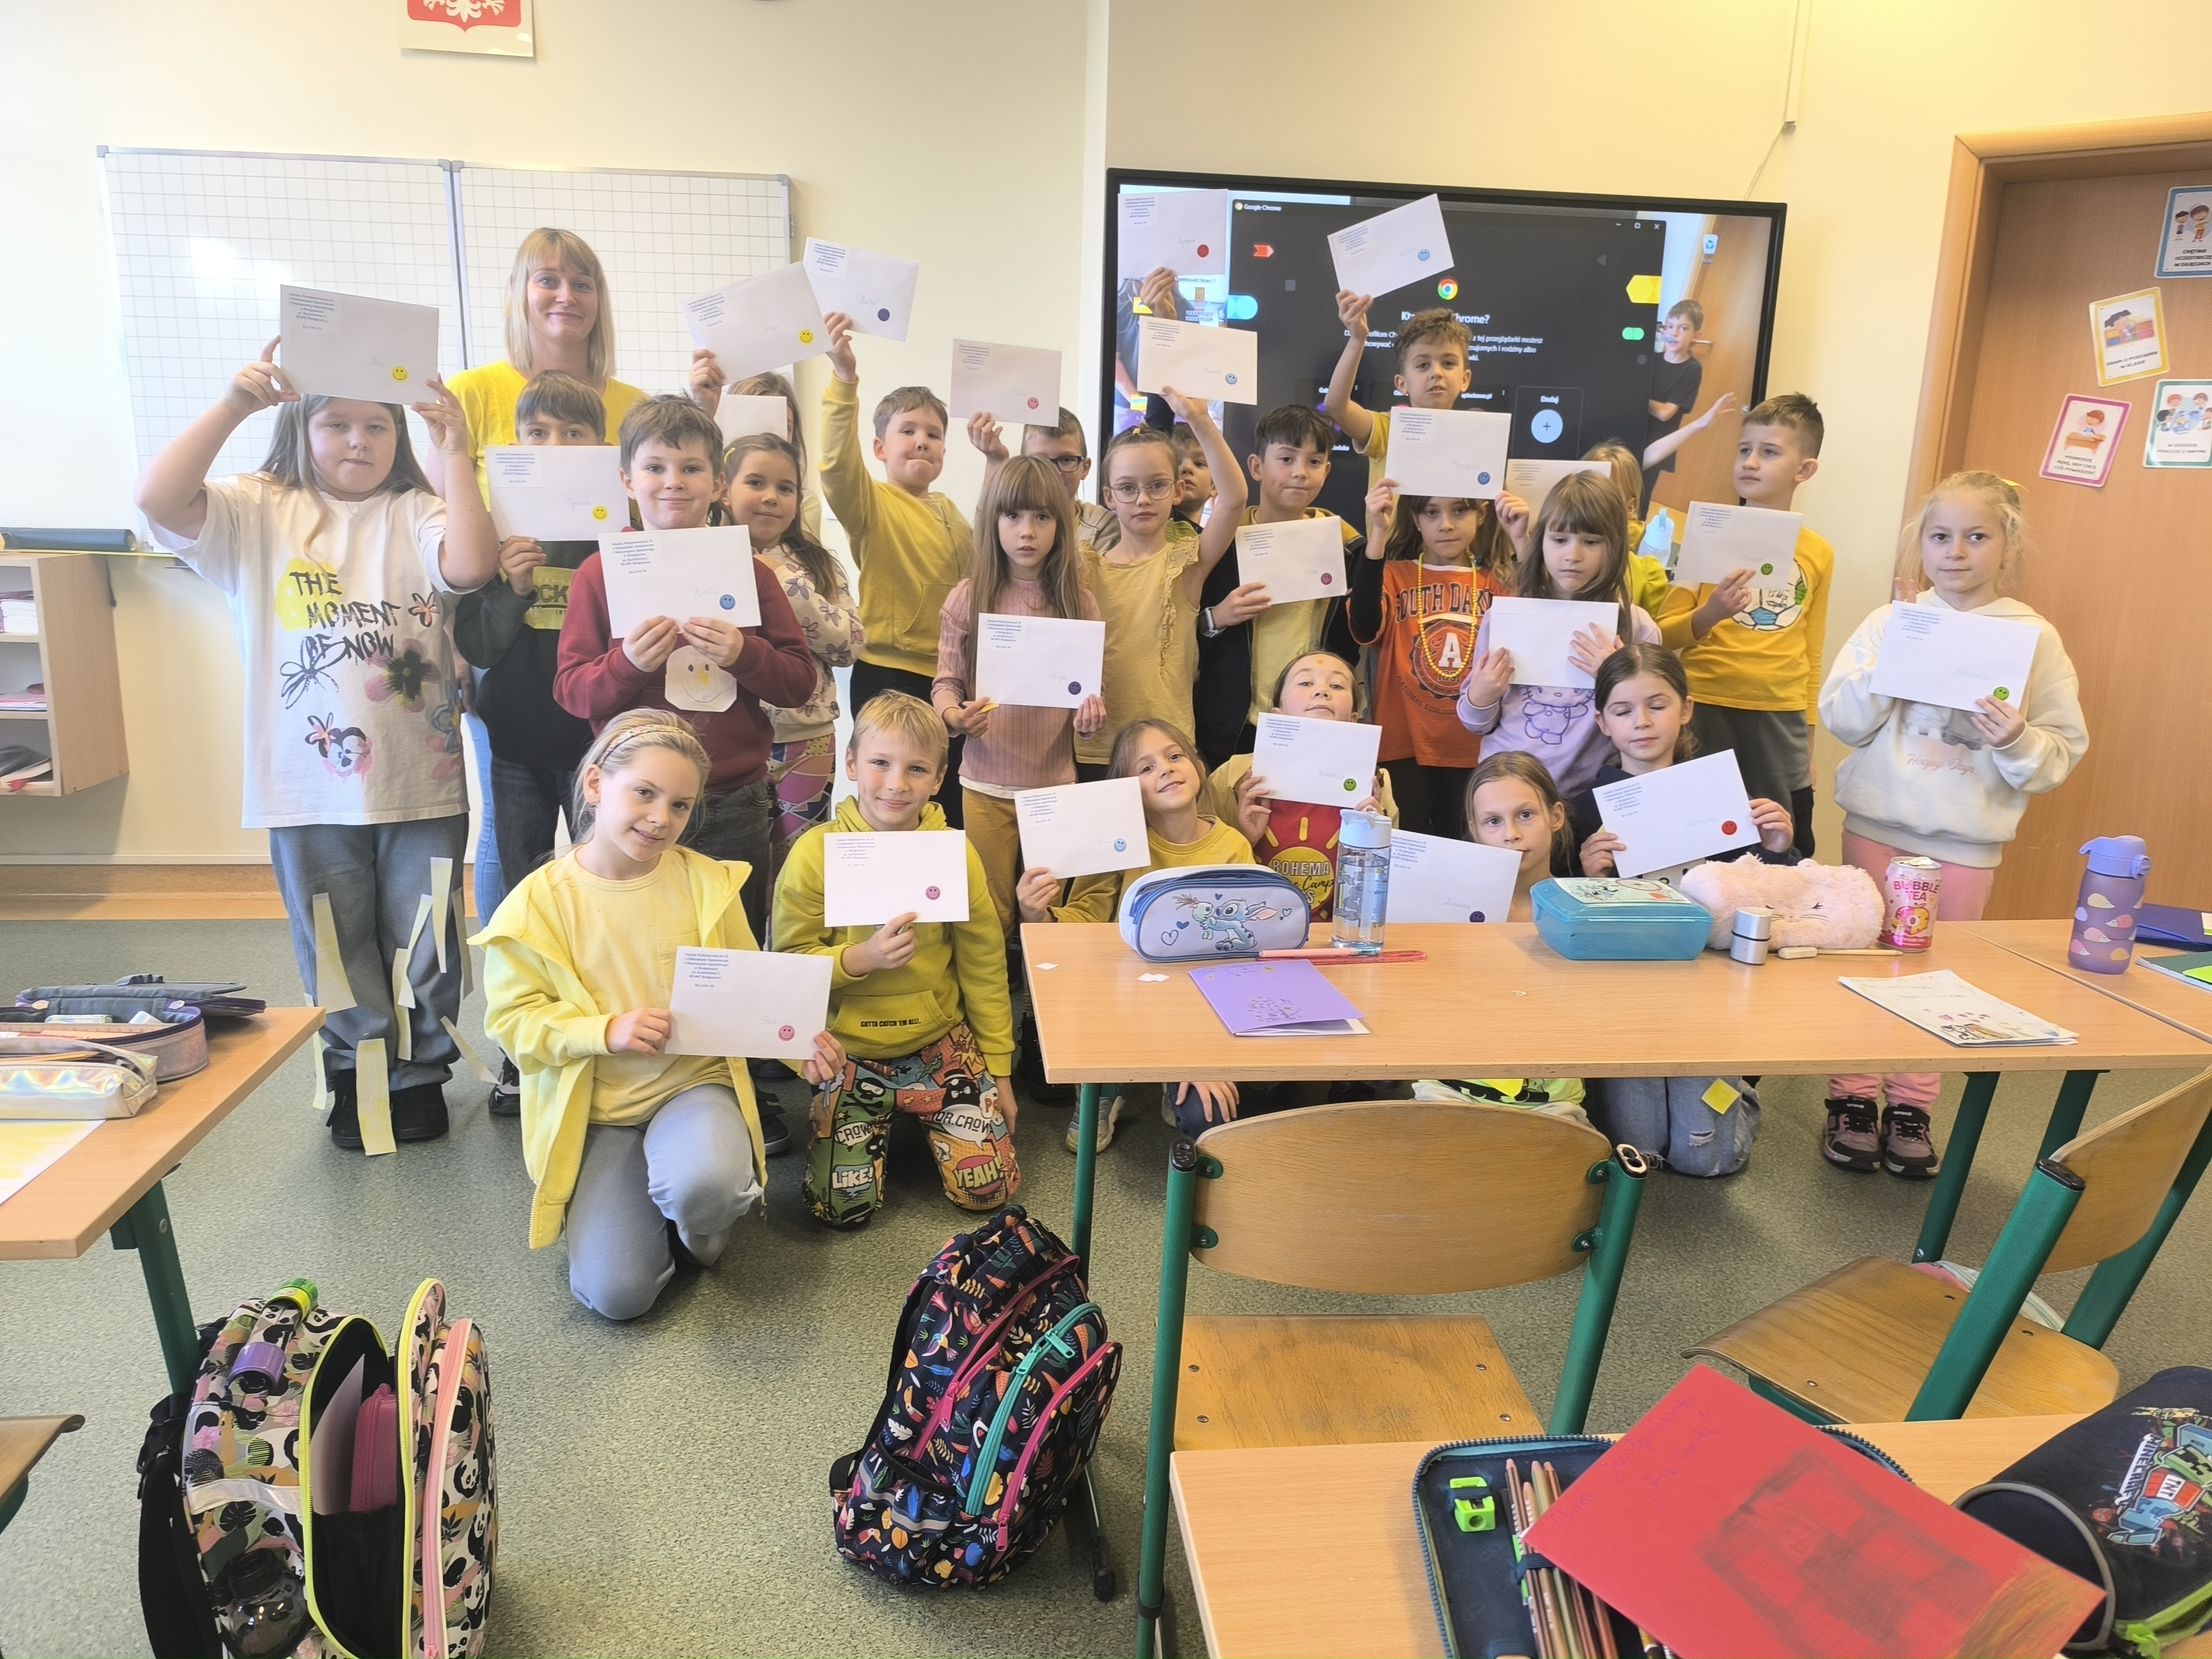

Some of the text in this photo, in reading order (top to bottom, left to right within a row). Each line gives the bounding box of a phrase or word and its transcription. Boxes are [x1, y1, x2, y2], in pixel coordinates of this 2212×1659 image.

[289, 571, 343, 596] THE
[306, 600, 402, 630] MOMENT
[342, 630, 394, 661] NOW
[1438, 632, 1464, 668] A
[1272, 859, 1330, 876] BOHEMA
[1302, 875, 1335, 893] Camp
[1893, 880, 1940, 894] BUBBLE
[1905, 891, 1927, 902] TEA
[955, 1150, 1005, 1189] YEAH!
[2114, 1433, 2162, 1506] MINECRAFT
[2158, 1476, 2183, 1498] TNT
